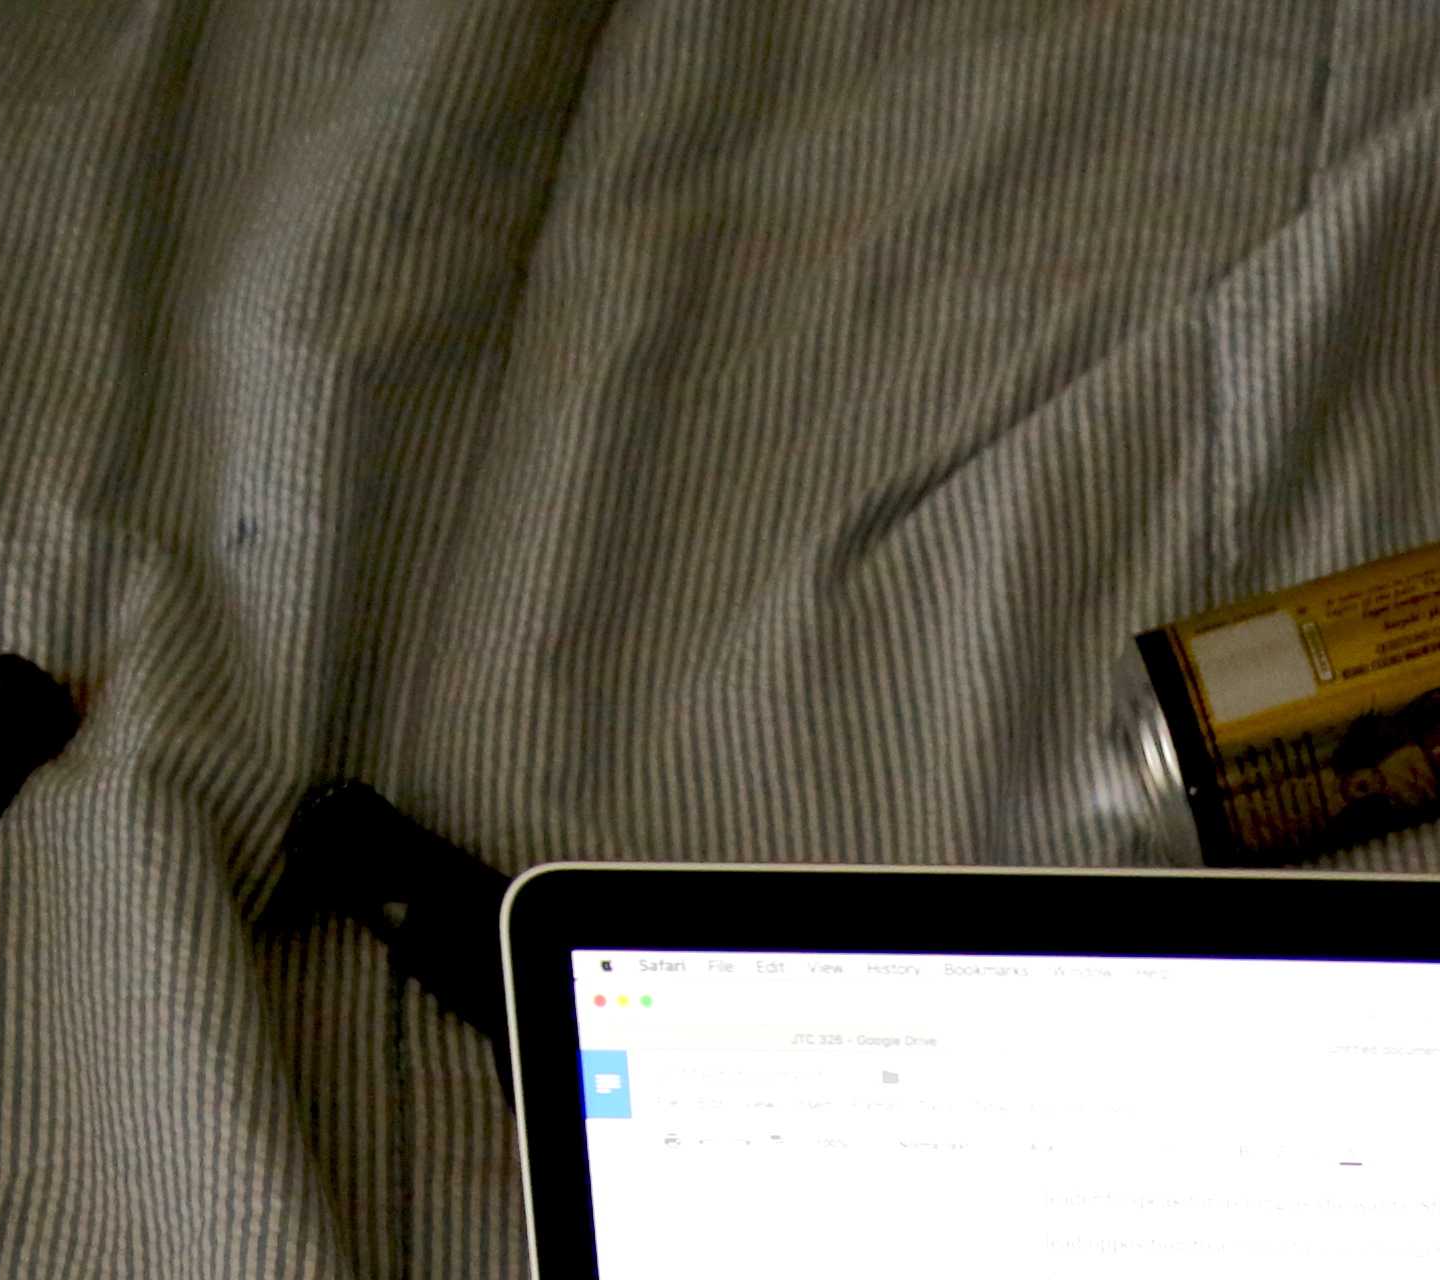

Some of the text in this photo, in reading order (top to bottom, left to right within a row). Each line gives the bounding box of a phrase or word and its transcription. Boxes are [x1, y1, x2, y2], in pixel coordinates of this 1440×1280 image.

[639, 959, 686, 973] Safari
[708, 960, 735, 973] File
[756, 961, 785, 974] Edit
